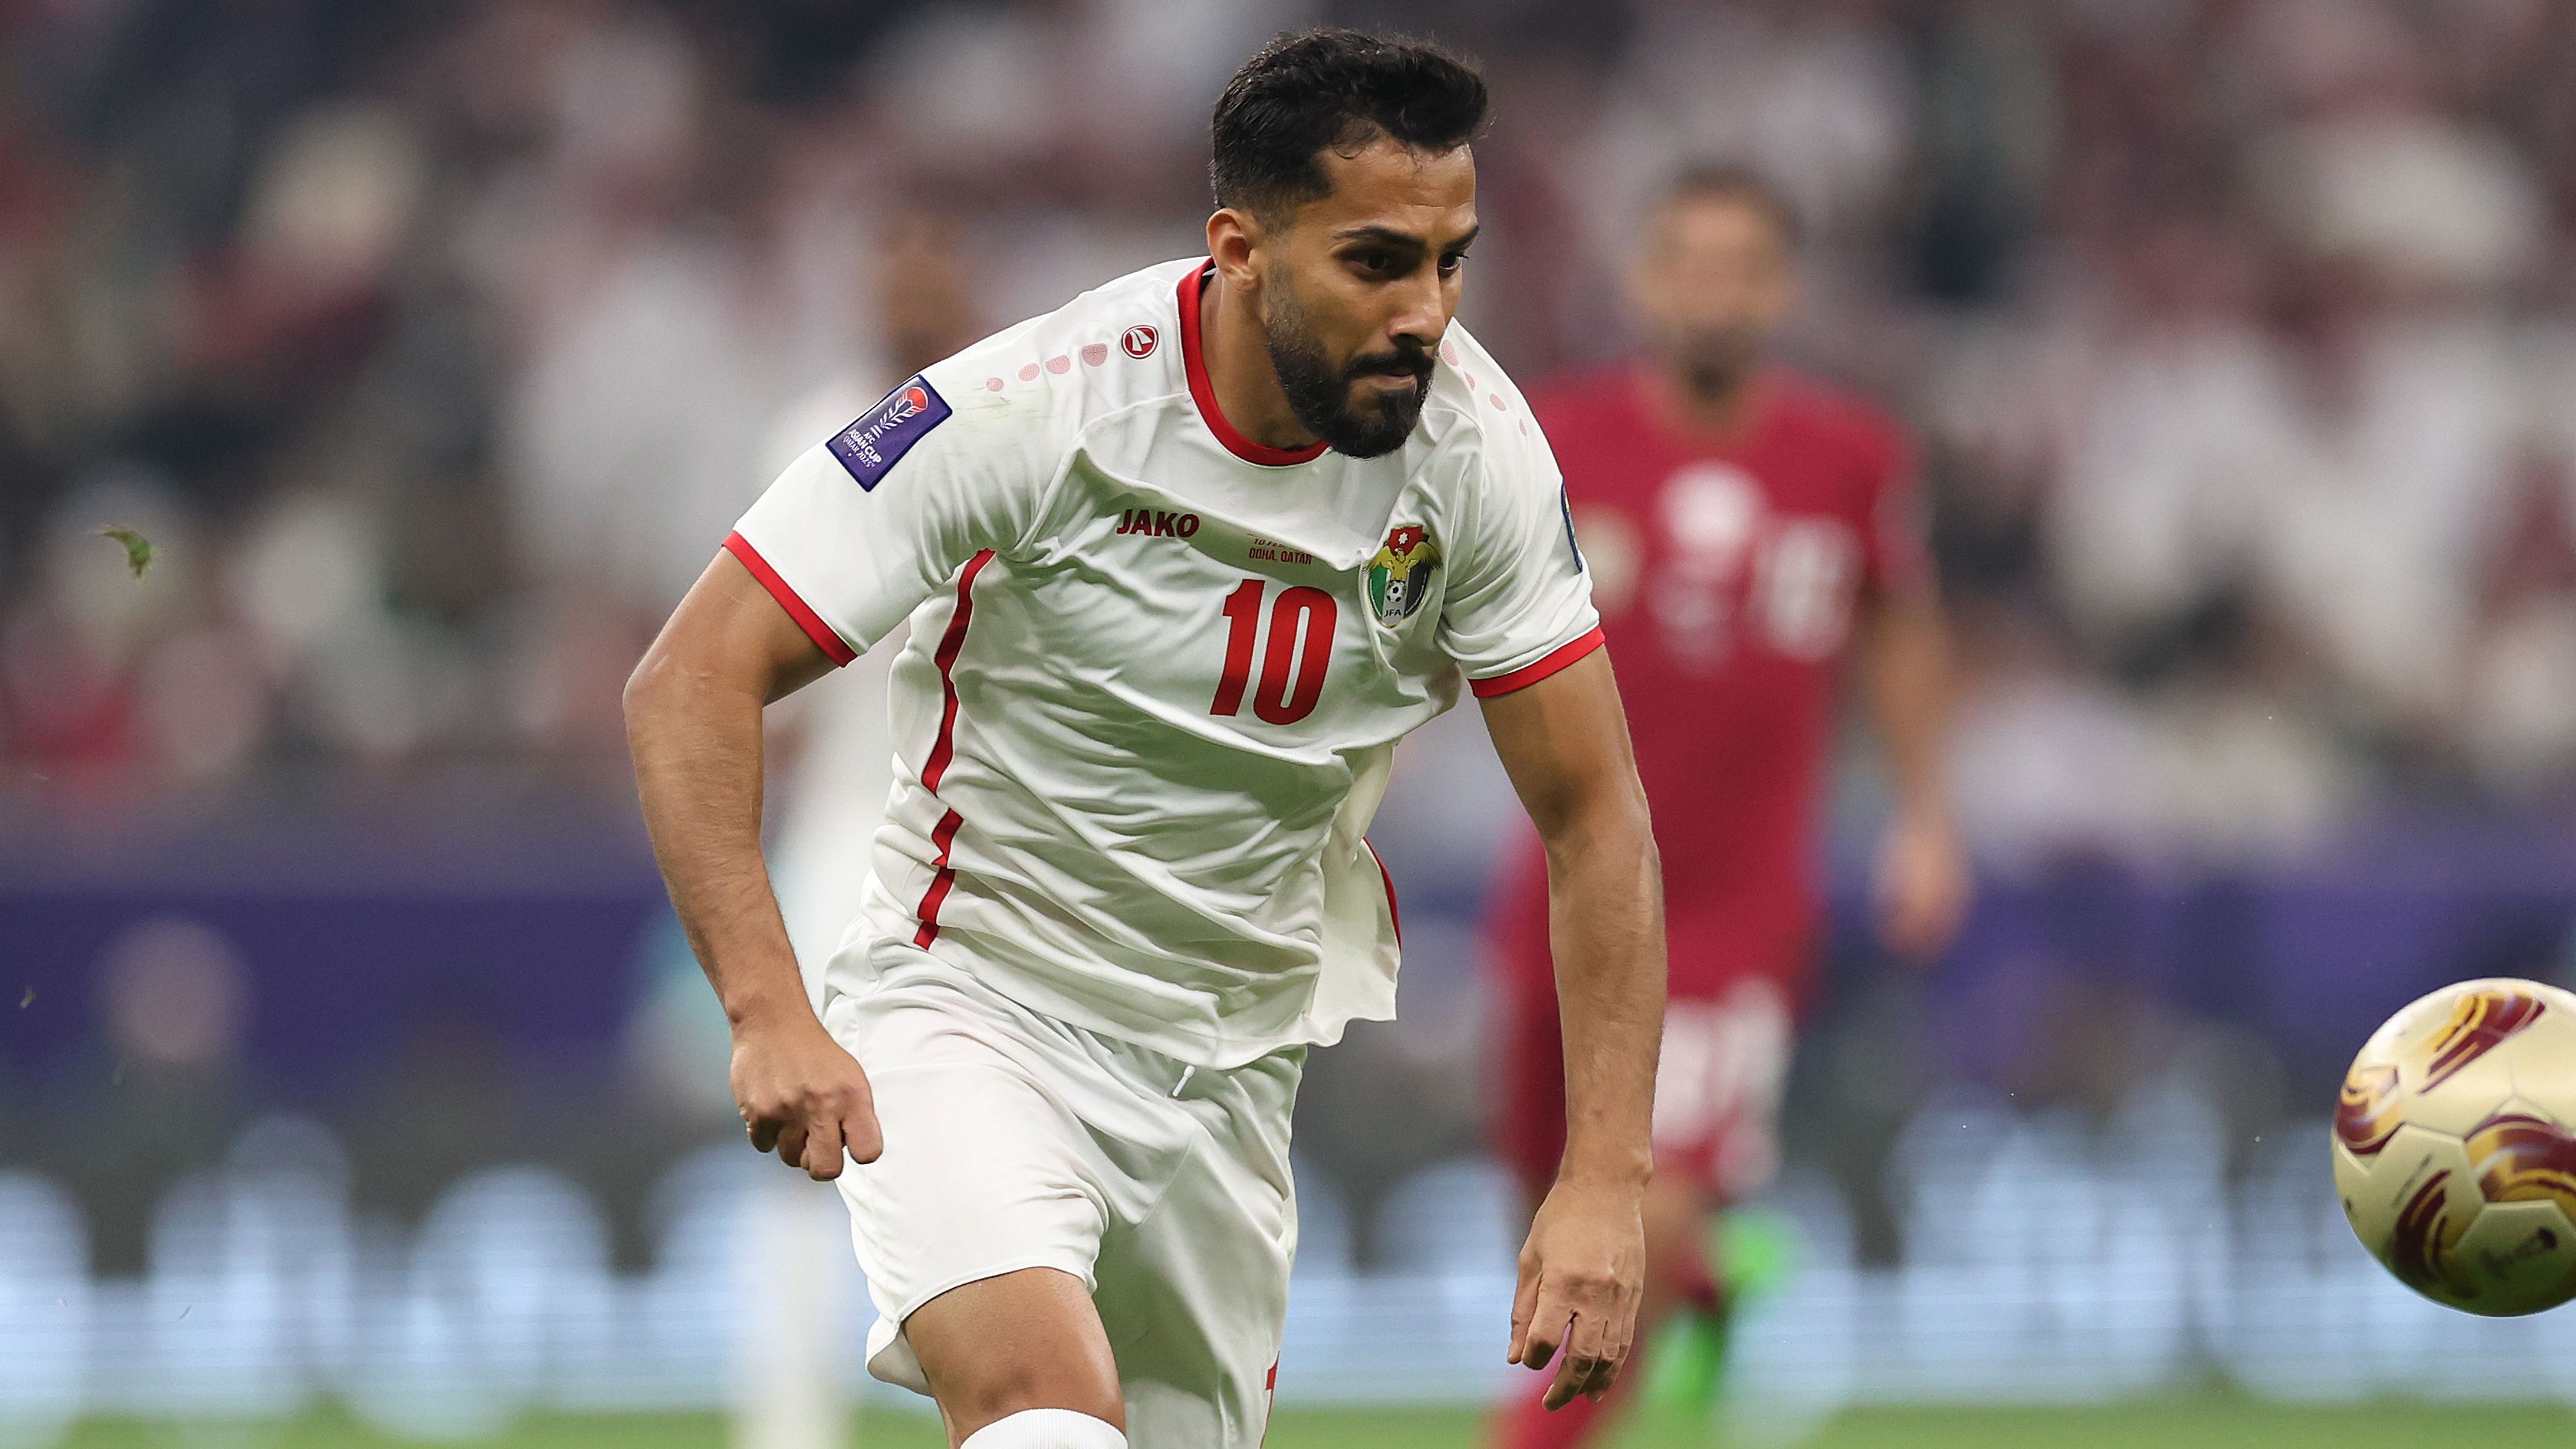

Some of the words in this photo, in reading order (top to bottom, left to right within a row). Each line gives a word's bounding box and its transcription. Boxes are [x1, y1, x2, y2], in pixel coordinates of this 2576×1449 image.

[843, 435, 860, 453] QATAR
[848, 429, 869, 449] ASIAN
[864, 445, 882, 463] CUP
[863, 432, 876, 445] AFC
[1116, 509, 1200, 537] JAKO
[1280, 550, 1313, 565] QATAR
[1384, 608, 1402, 618] JFA
[1209, 579, 1338, 725] 10
